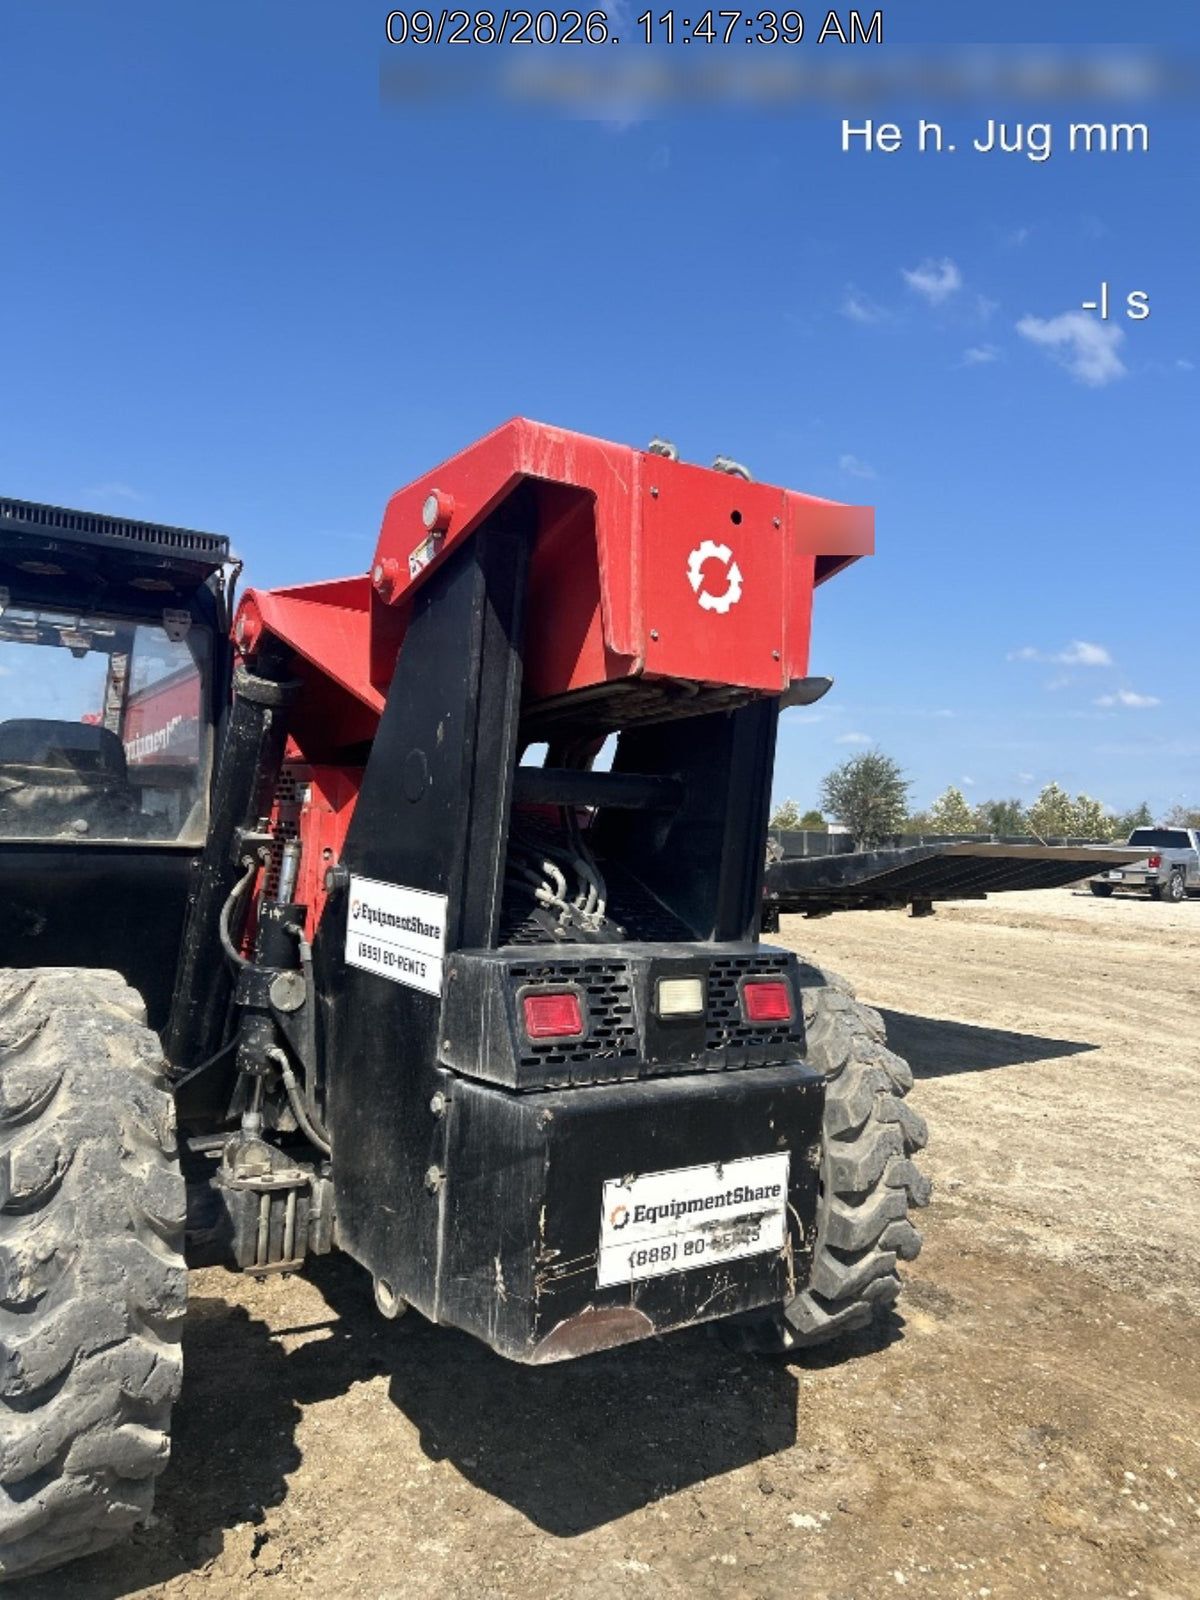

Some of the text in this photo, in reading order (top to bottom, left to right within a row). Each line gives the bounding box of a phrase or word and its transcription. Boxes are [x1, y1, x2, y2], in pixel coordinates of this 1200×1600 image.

[361, 903, 441, 939] EquipmentShare
[633, 1184, 781, 1224] EquipmentShare
[628, 1242, 677, 1268] (888)
